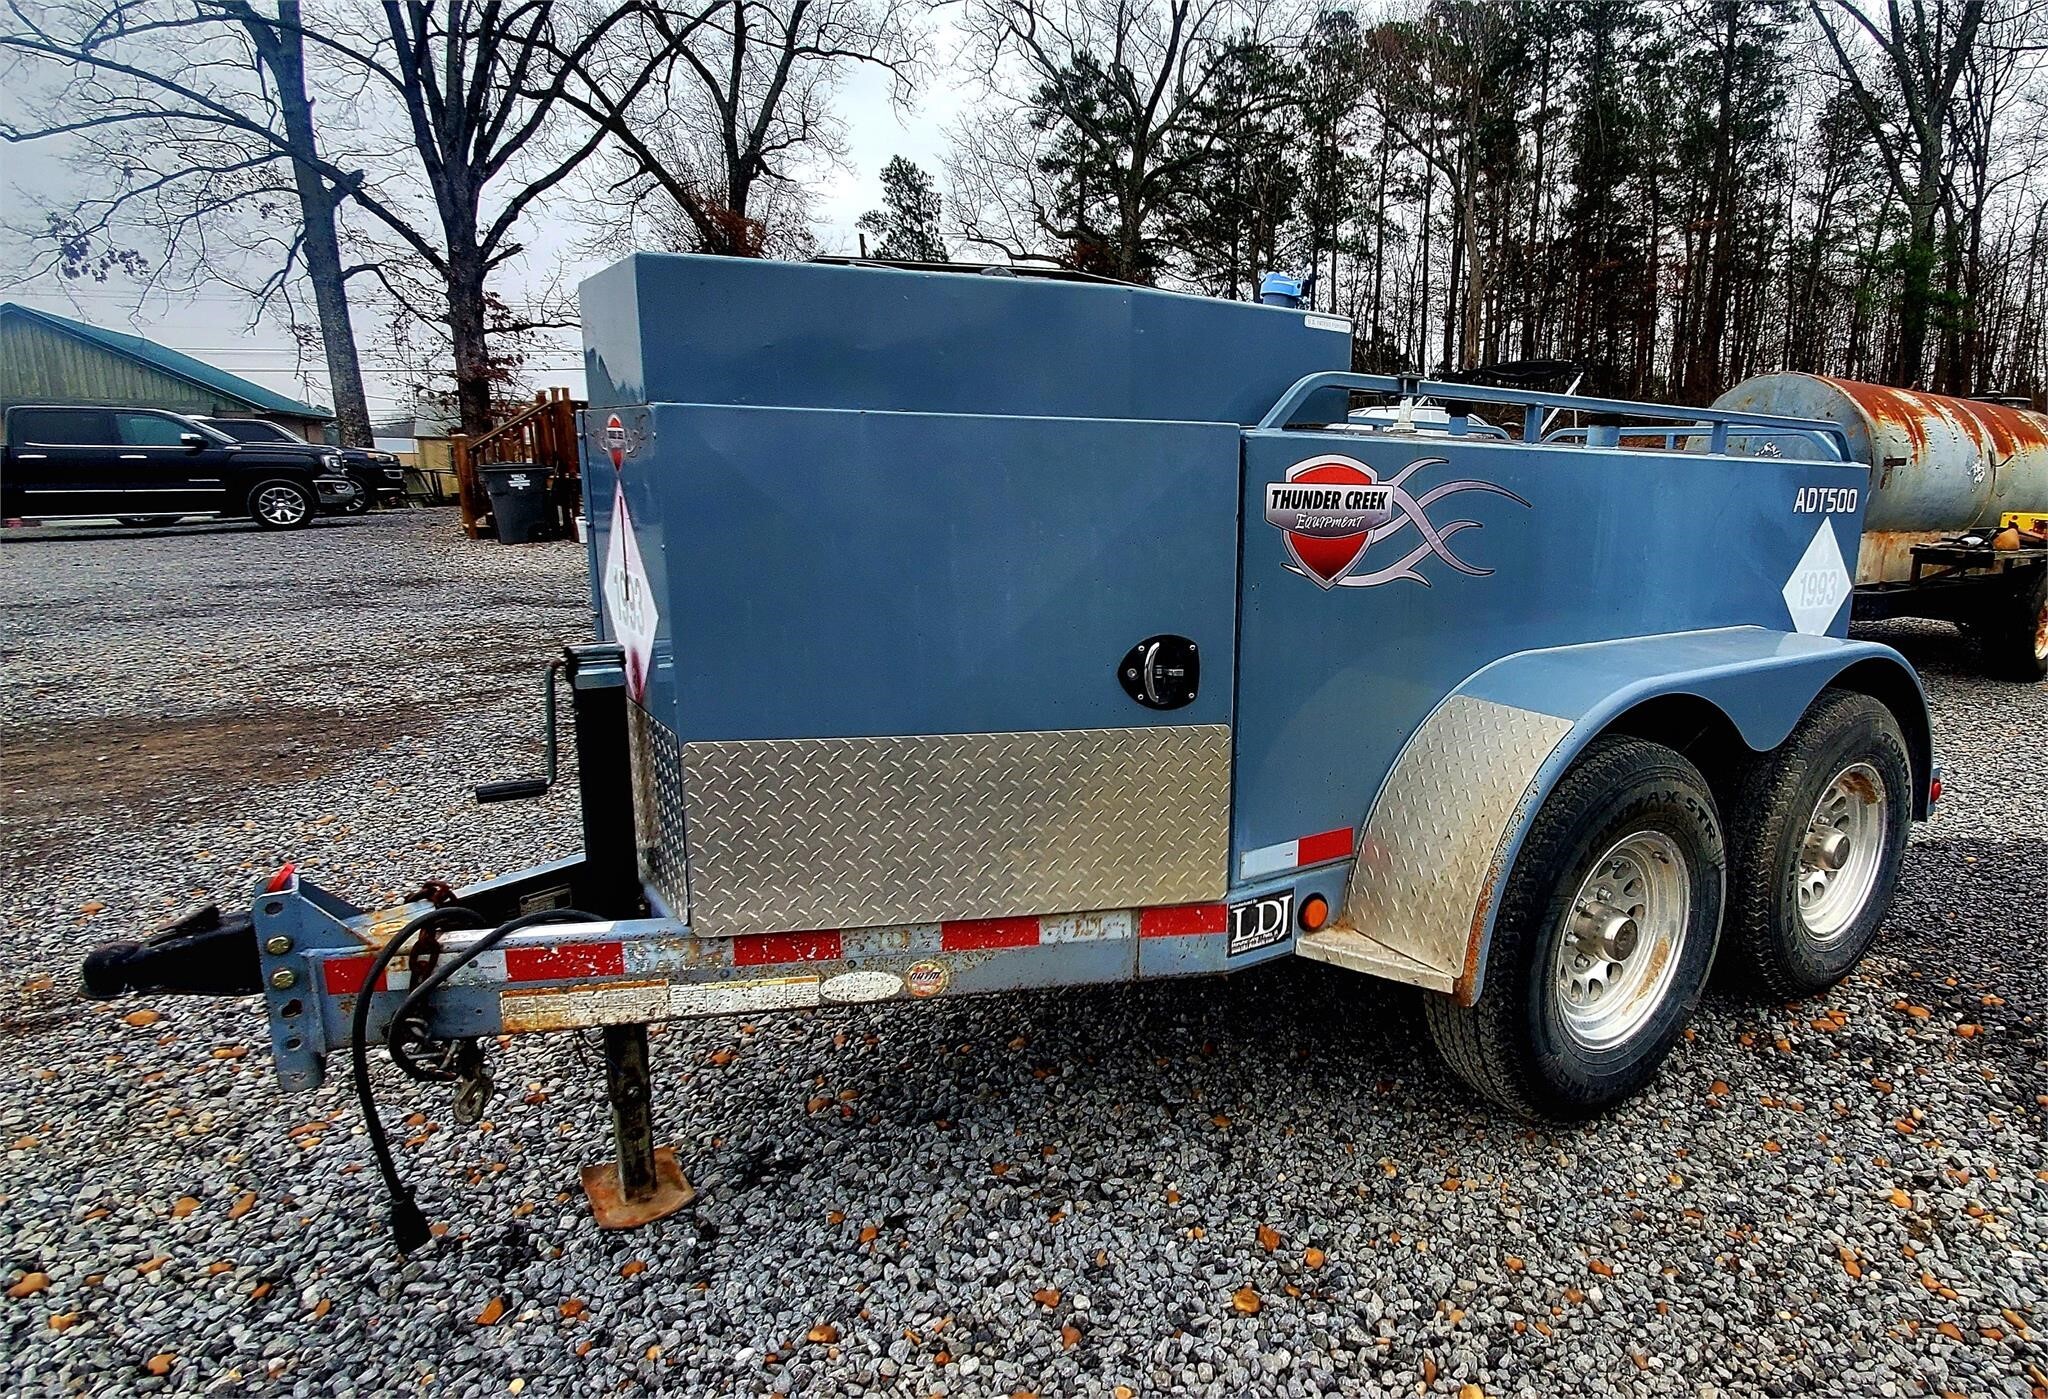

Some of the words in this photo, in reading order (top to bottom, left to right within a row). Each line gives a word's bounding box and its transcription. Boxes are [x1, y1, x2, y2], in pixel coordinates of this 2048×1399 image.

[1271, 489, 1341, 510] THUNDER
[1345, 490, 1388, 510] CREEK
[1793, 487, 1858, 513] ADT500
[1800, 571, 1837, 606] 1993
[1232, 894, 1293, 941] LDJ
